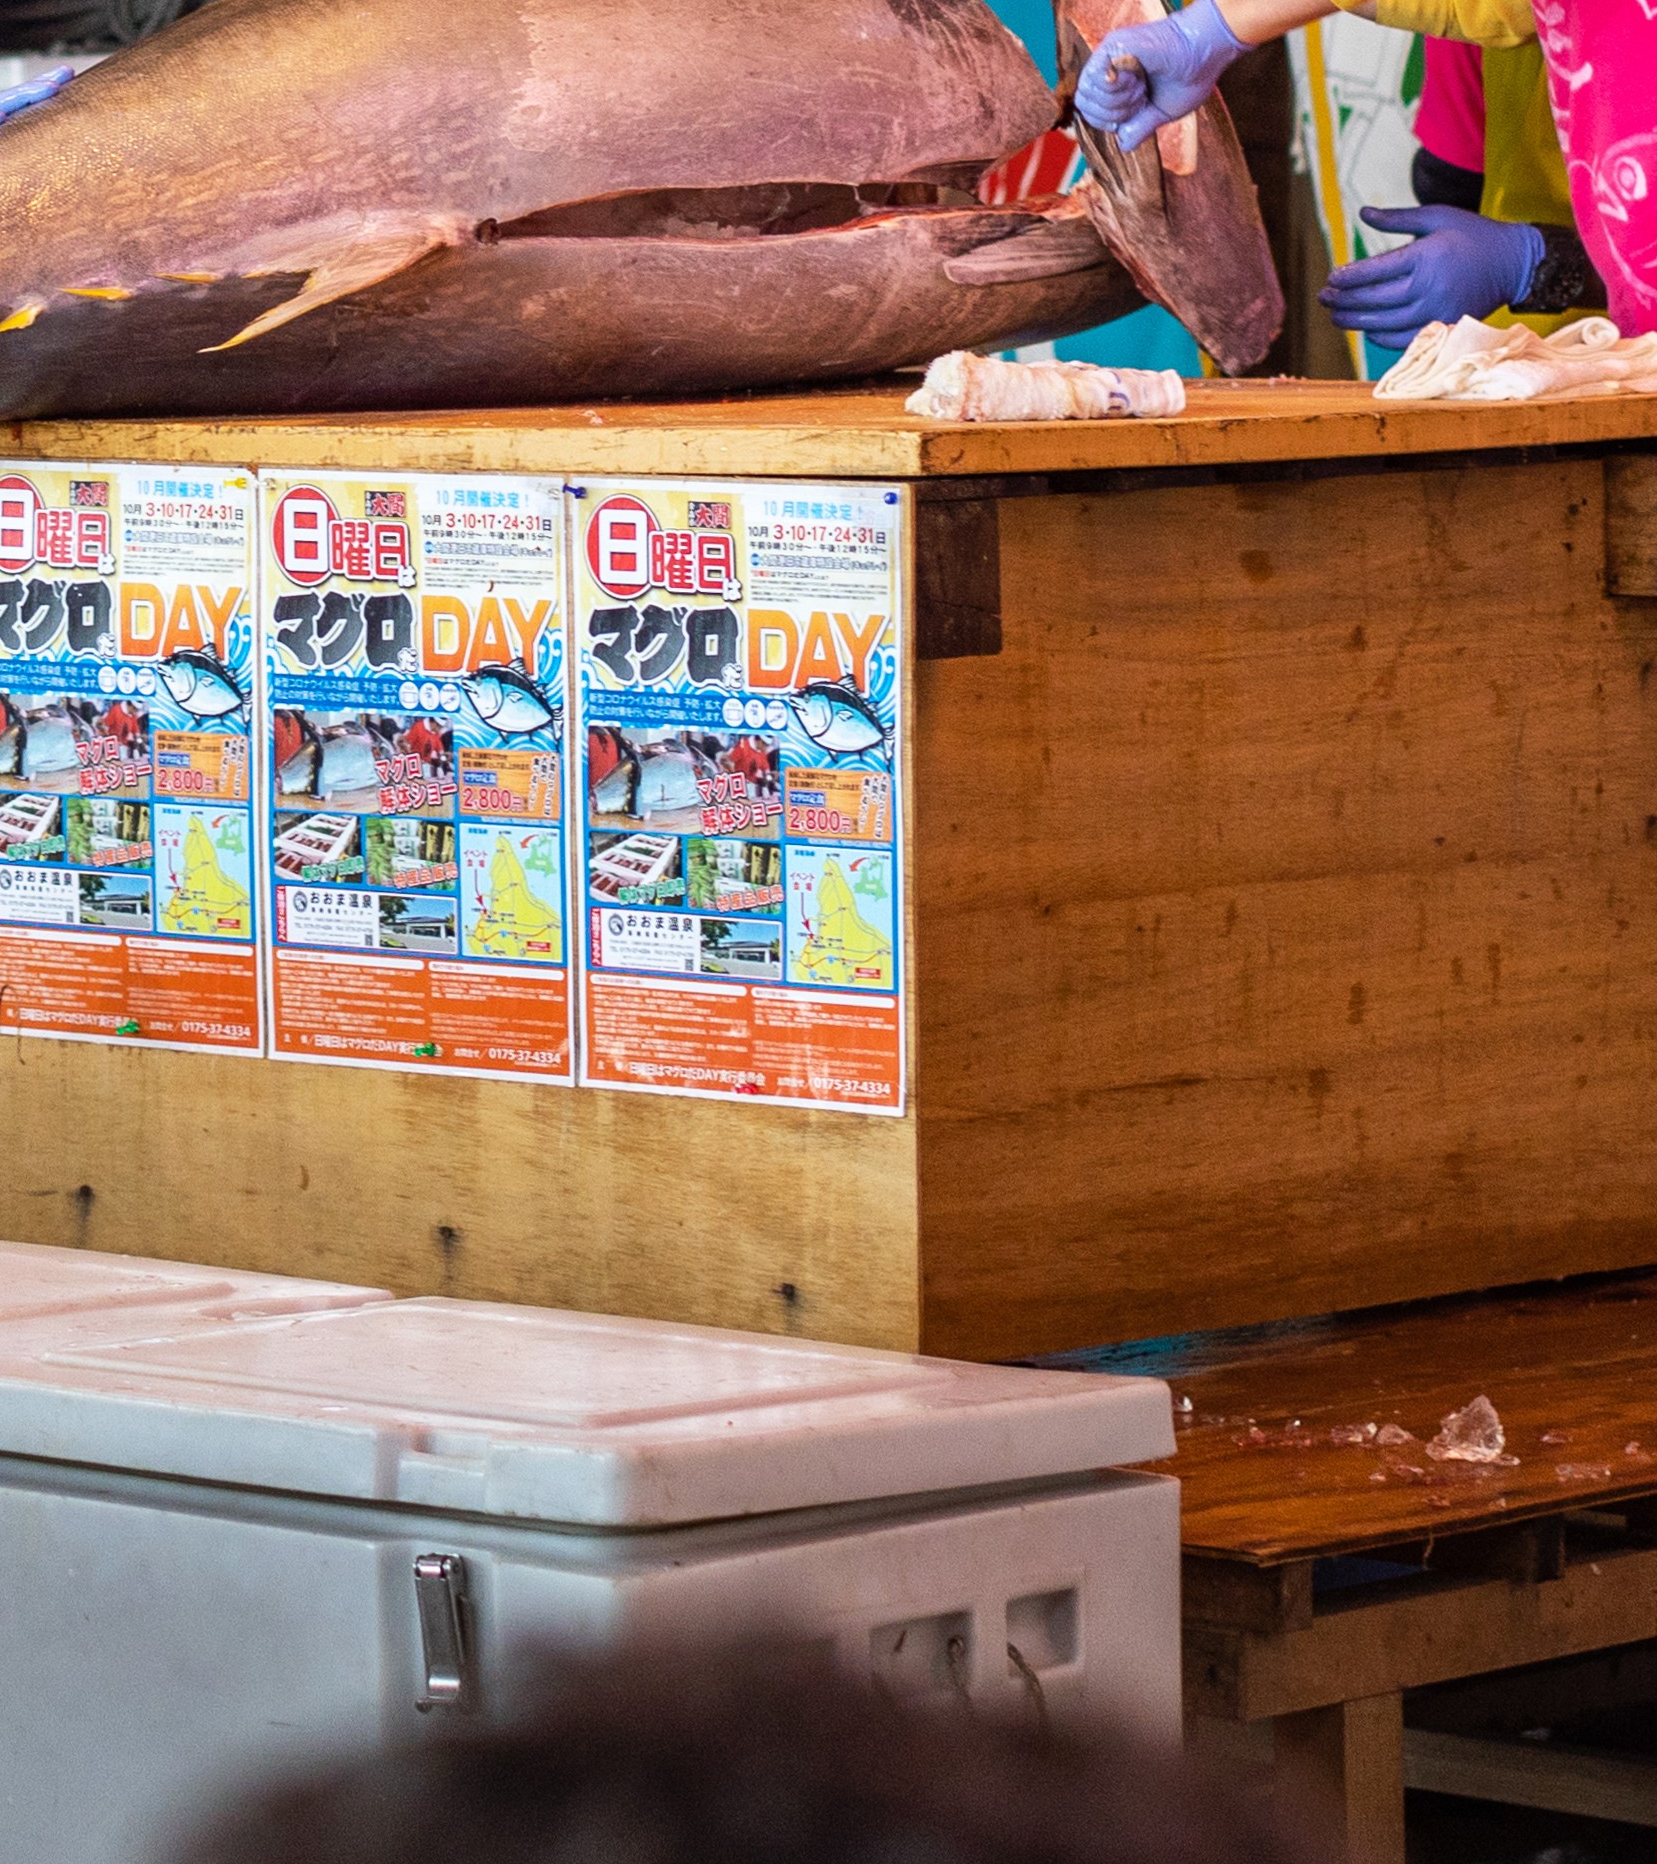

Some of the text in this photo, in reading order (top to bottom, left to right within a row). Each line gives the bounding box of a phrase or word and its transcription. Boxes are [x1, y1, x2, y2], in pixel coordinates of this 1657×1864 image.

[120, 581, 245, 663] DAY
[421, 594, 555, 678] DAY
[747, 608, 888, 696] DAY
[76, 734, 120, 765] マグロ
[375, 752, 423, 783] マグロ
[697, 771, 747, 803] マグロ
[701, 802, 784, 835] 解体ショー
[179, 1021, 250, 1041] 0175-37-4334
[486, 1047, 562, 1068] 0175-37-4334
[812, 1076, 892, 1097] 0175-37-4334
